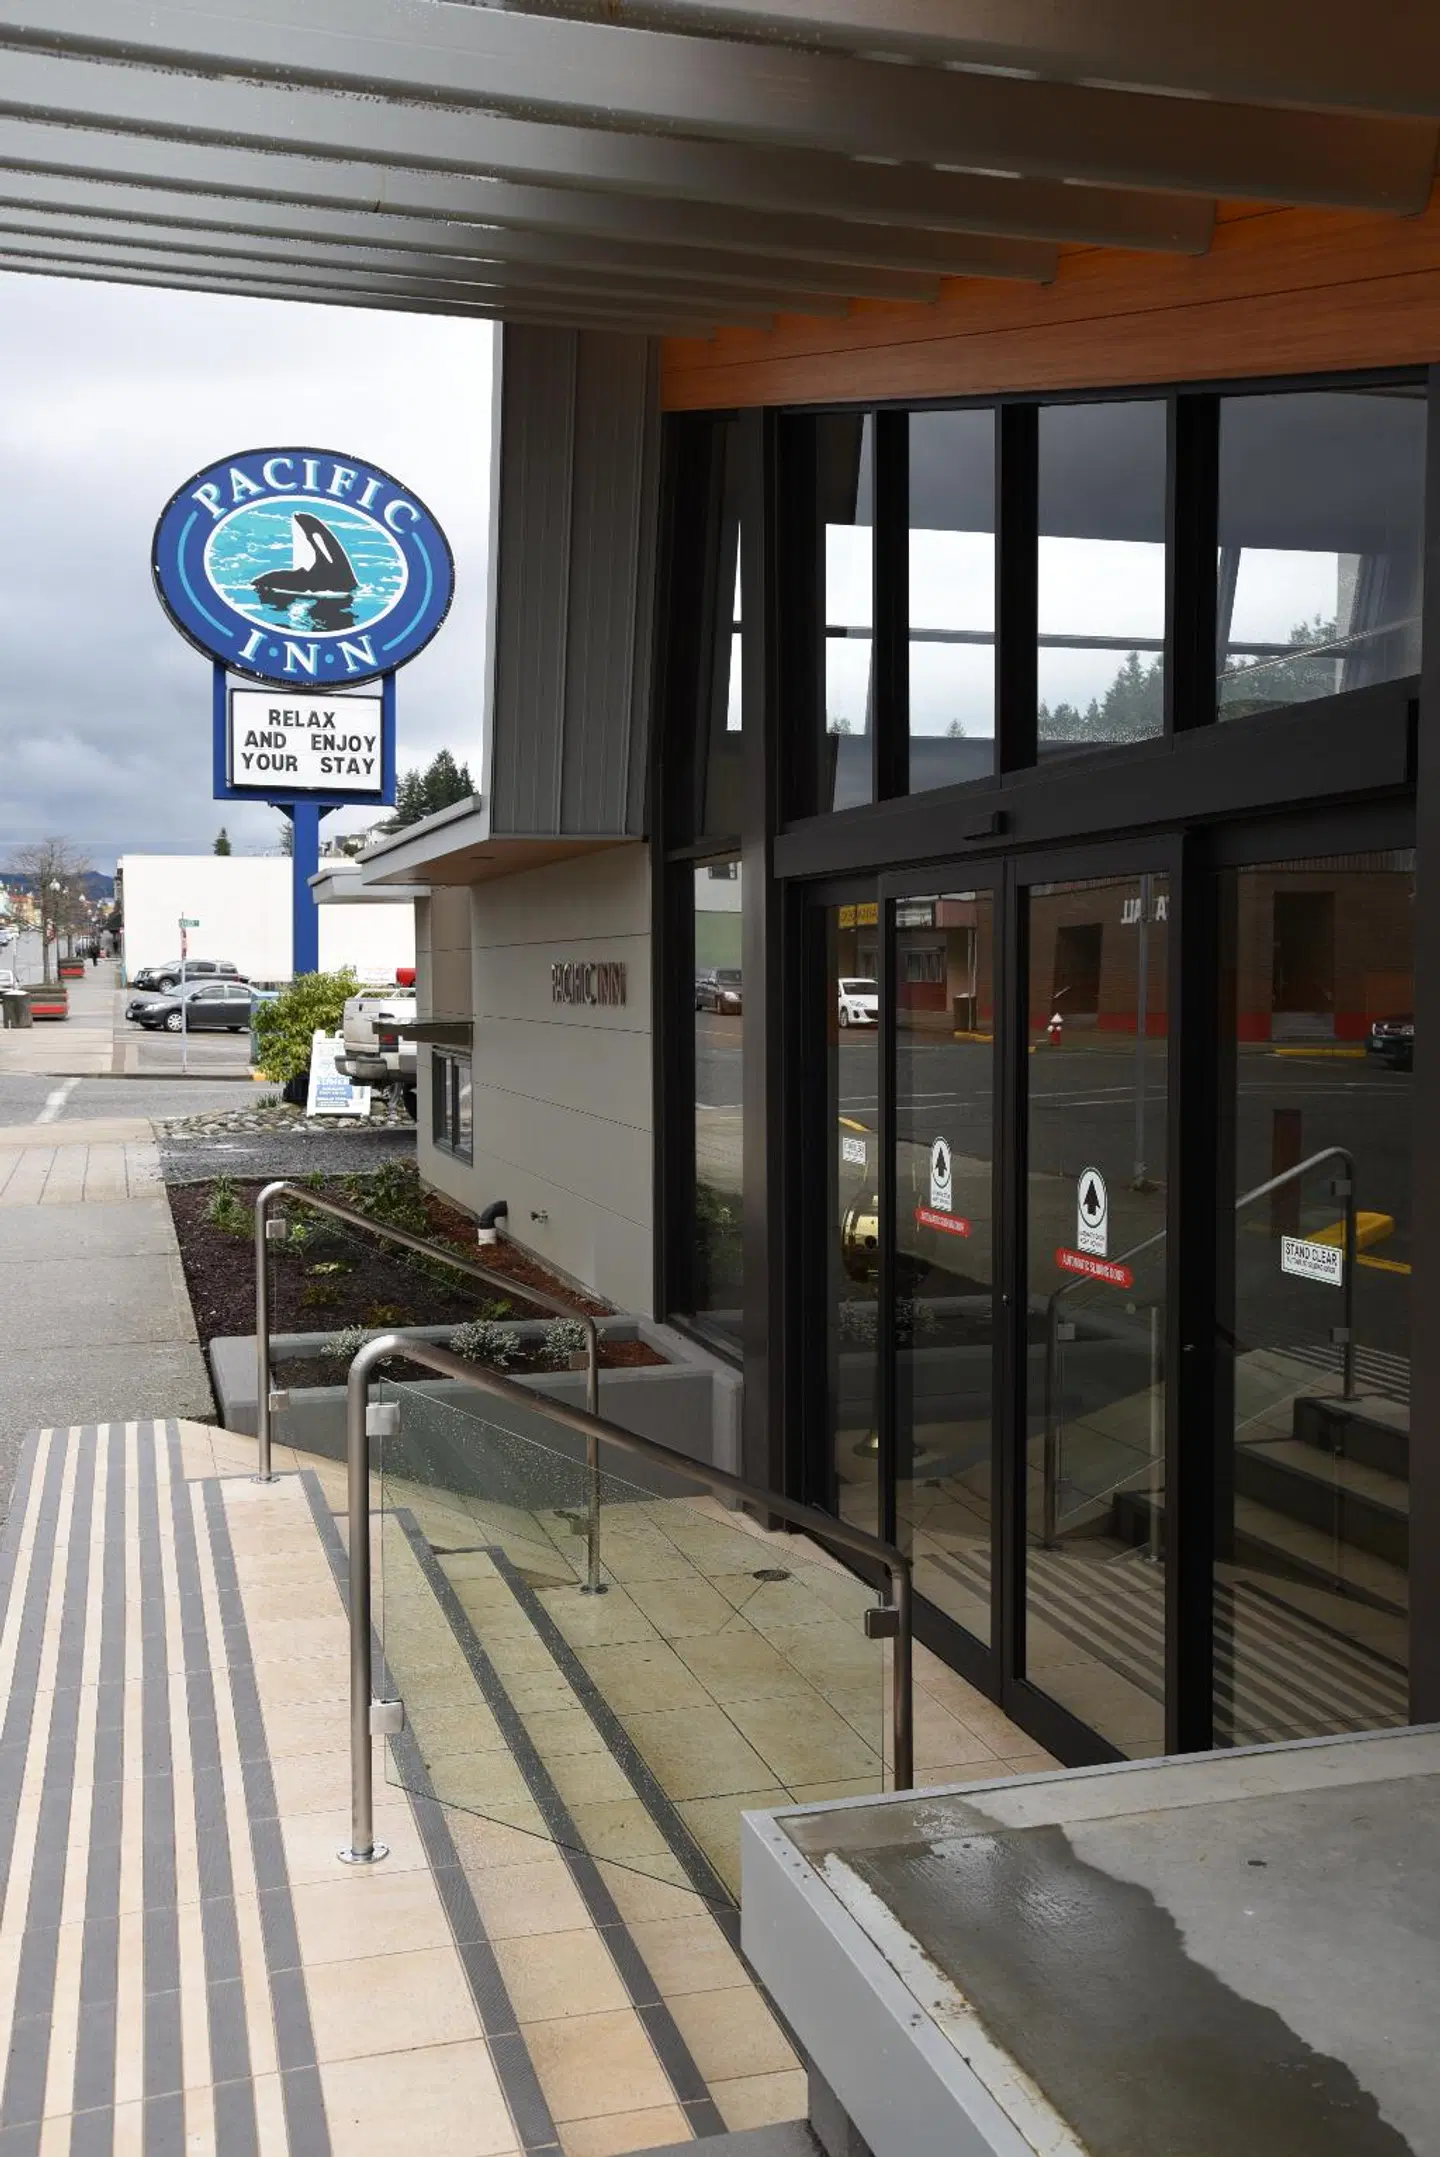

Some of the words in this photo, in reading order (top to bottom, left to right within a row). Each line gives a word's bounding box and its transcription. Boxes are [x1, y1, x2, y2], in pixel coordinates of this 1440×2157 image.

[192, 457, 422, 534] PACIFIC
[268, 708, 336, 729] RELAX
[244, 730, 287, 749] AND
[311, 733, 376, 753] ENJOY
[241, 752, 298, 772] YOUR
[320, 756, 375, 775] STAY
[1285, 1242, 1311, 1260] STAND
[1312, 1249, 1338, 1267] CLEAR
